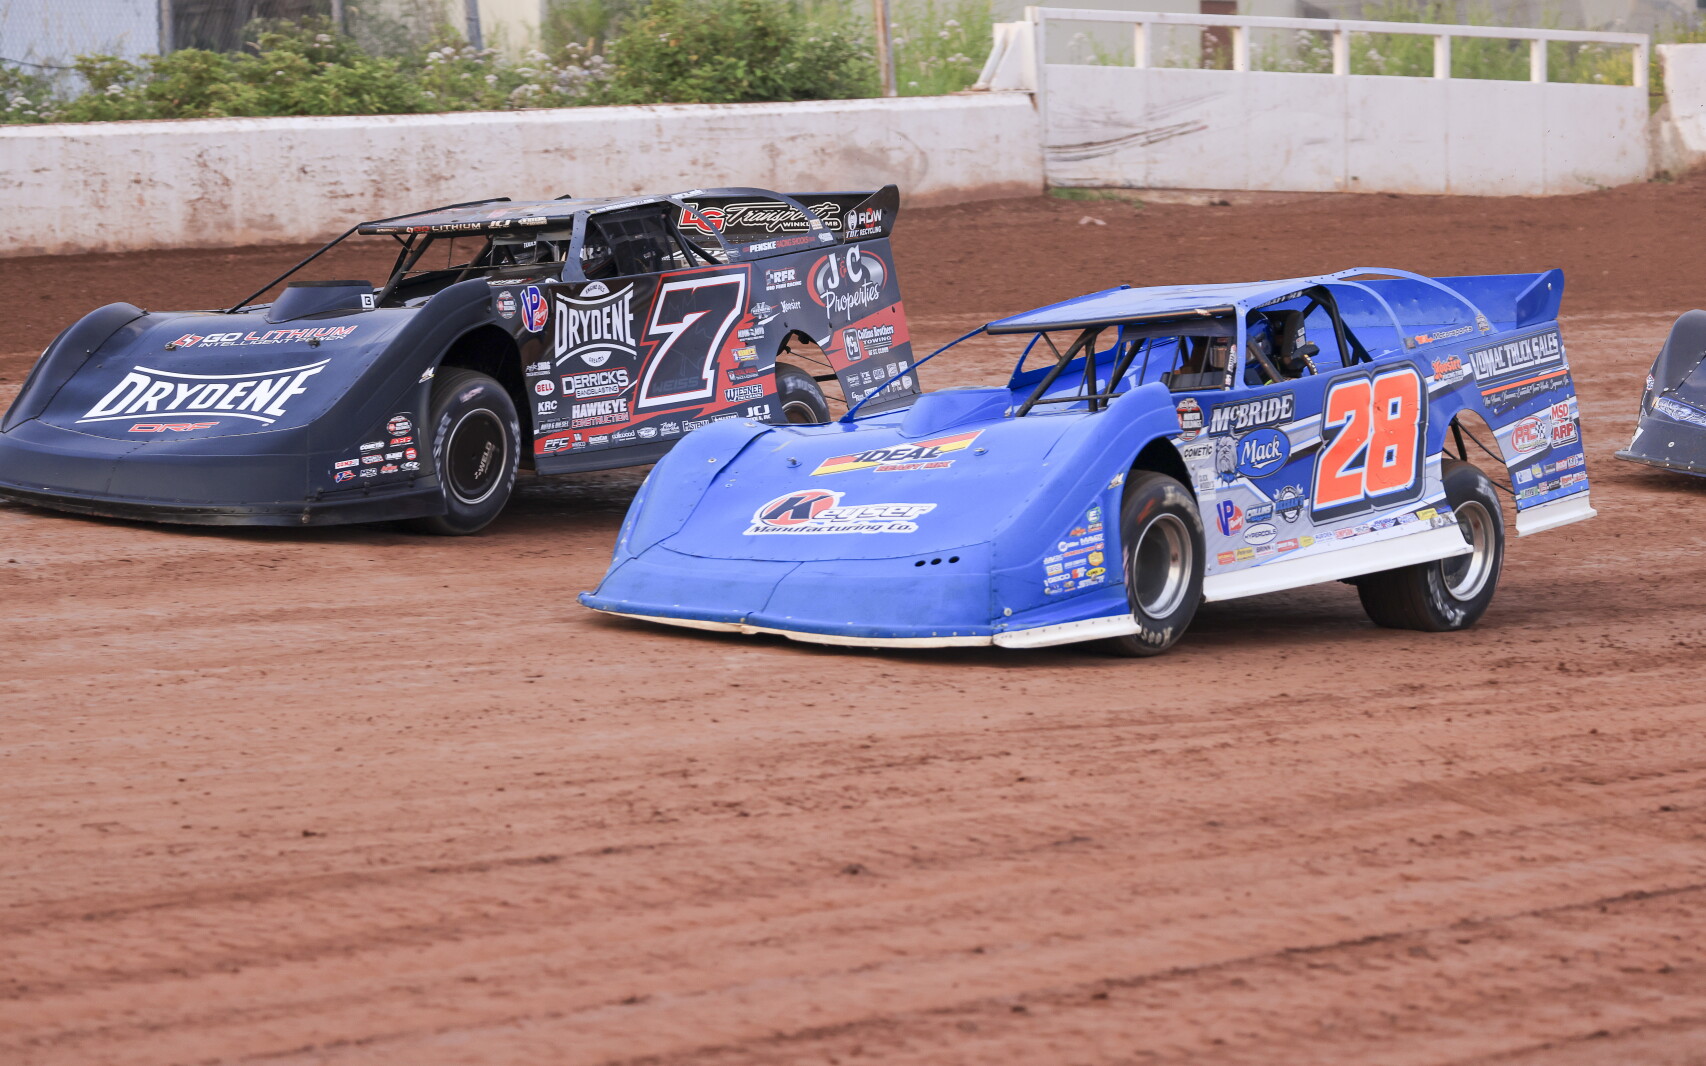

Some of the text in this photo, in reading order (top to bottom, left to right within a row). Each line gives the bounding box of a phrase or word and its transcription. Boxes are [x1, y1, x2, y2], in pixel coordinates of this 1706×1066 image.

[432, 223, 481, 231] LITHIUM
[860, 226, 881, 236] RECYCLING
[749, 241, 777, 253] PENSKE
[774, 269, 796, 284] RFR
[520, 285, 541, 331] VP
[820, 282, 880, 321] Properties
[555, 289, 636, 358] DRYDENE
[203, 325, 358, 343] GO LITHIUM
[638, 273, 746, 408] 7
[863, 336, 892, 345] TOWING
[1433, 325, 1473, 340] Motorsports
[198, 338, 292, 348] INTELLIGENT
[1504, 339, 1533, 370] TRUCK
[1531, 333, 1559, 365] SALES
[536, 382, 553, 392] BELL
[562, 369, 629, 395] DERRICK'S
[82, 365, 326, 418] DRYDENE
[576, 384, 619, 397] SANDBLASTING
[724, 384, 763, 401] WIESNER
[538, 400, 558, 412] KRC
[572, 398, 627, 419] HAWKEYE
[746, 404, 770, 417] JCJ
[1552, 404, 1569, 419] MSD
[128, 421, 220, 433] DRF
[572, 412, 629, 429] CONSTRUCTION
[1312, 368, 1420, 511] 28
[1553, 423, 1574, 440] ARP
[544, 437, 569, 448] PFC
[1240, 435, 1282, 465] Mack
[853, 446, 941, 462] IDEAL
[1184, 445, 1213, 458] COMETIC
[761, 495, 931, 522] Keyser
[1216, 500, 1234, 536] VP
[750, 523, 912, 534] Manufacturing Co.
